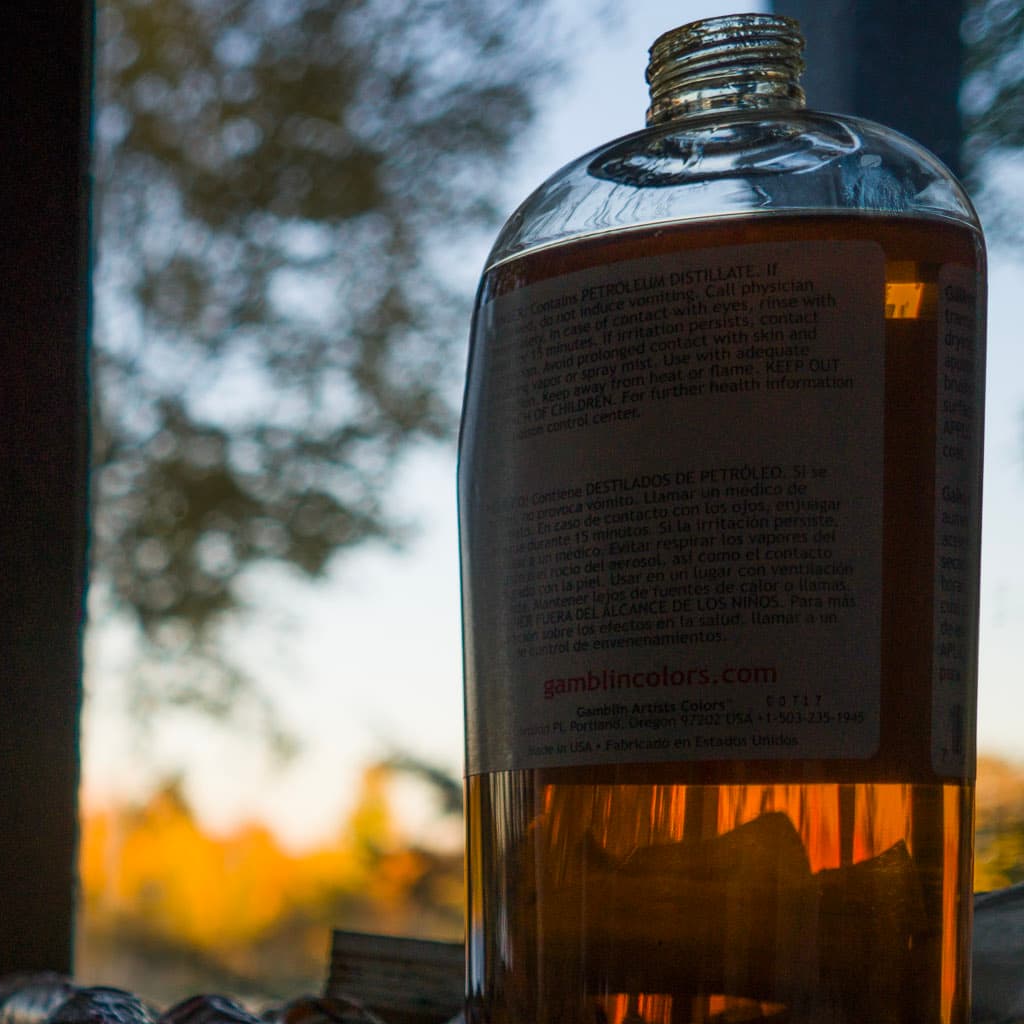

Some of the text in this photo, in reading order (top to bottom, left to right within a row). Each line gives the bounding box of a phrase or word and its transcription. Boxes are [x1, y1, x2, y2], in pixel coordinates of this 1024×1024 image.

[581, 276, 664, 300] PETROLEUM
[767, 262, 778, 277] If
[580, 300, 624, 318] induce
[706, 283, 735, 298] Call
[742, 279, 813, 296] physician
[596, 317, 607, 330] of
[613, 307, 667, 326] contact
[672, 301, 707, 316] with
[760, 296, 798, 309] rinse
[803, 293, 836, 308] with
[618, 319, 683, 342] irritation
[760, 312, 816, 325] contact
[577, 327, 816, 365] prolonged contact with skin and
[664, 353, 690, 366] Use
[696, 348, 730, 361] with
[735, 345, 809, 361] adequate
[611, 375, 644, 390] from
[649, 370, 684, 384] heat
[688, 368, 704, 379] or
[766, 359, 803, 373] KEEP
[808, 358, 840, 372] OUT
[622, 390, 644, 403] For
[651, 383, 706, 400] further
[709, 380, 760, 393] health
[766, 375, 854, 390] information
[546, 413, 587, 432] control
[586, 472, 670, 495] DESTILADOS
[675, 471, 695, 485] DE
[793, 465, 806, 478] Si
[810, 467, 827, 478] se
[701, 488, 720, 498] un
[787, 482, 807, 494] de
[604, 507, 667, 524] contacto
[672, 504, 699, 515] con
[705, 503, 727, 513] los
[677, 518, 690, 531] la
[608, 540, 649, 555] Evitar
[722, 533, 743, 545] los
[812, 529, 836, 544] del
[698, 550, 740, 562] como
[746, 548, 759, 560] el
[766, 548, 832, 560] contacto
[646, 572, 664, 582] en
[670, 570, 687, 581] un
[738, 564, 765, 577] con
[715, 581, 735, 594] de
[576, 608, 599, 620] DEL
[603, 602, 667, 617] ALCANCE
[673, 600, 695, 612] DE
[697, 597, 726, 611] LOS
[790, 595, 823, 608] Para
[656, 619, 674, 629] en
[544, 664, 777, 700] gamblincolors.com
[576, 703, 675, 718] Gamblin Artists
[726, 711, 752, 724] USA
[570, 733, 798, 752] USA Fabricado en Estados Unidos
